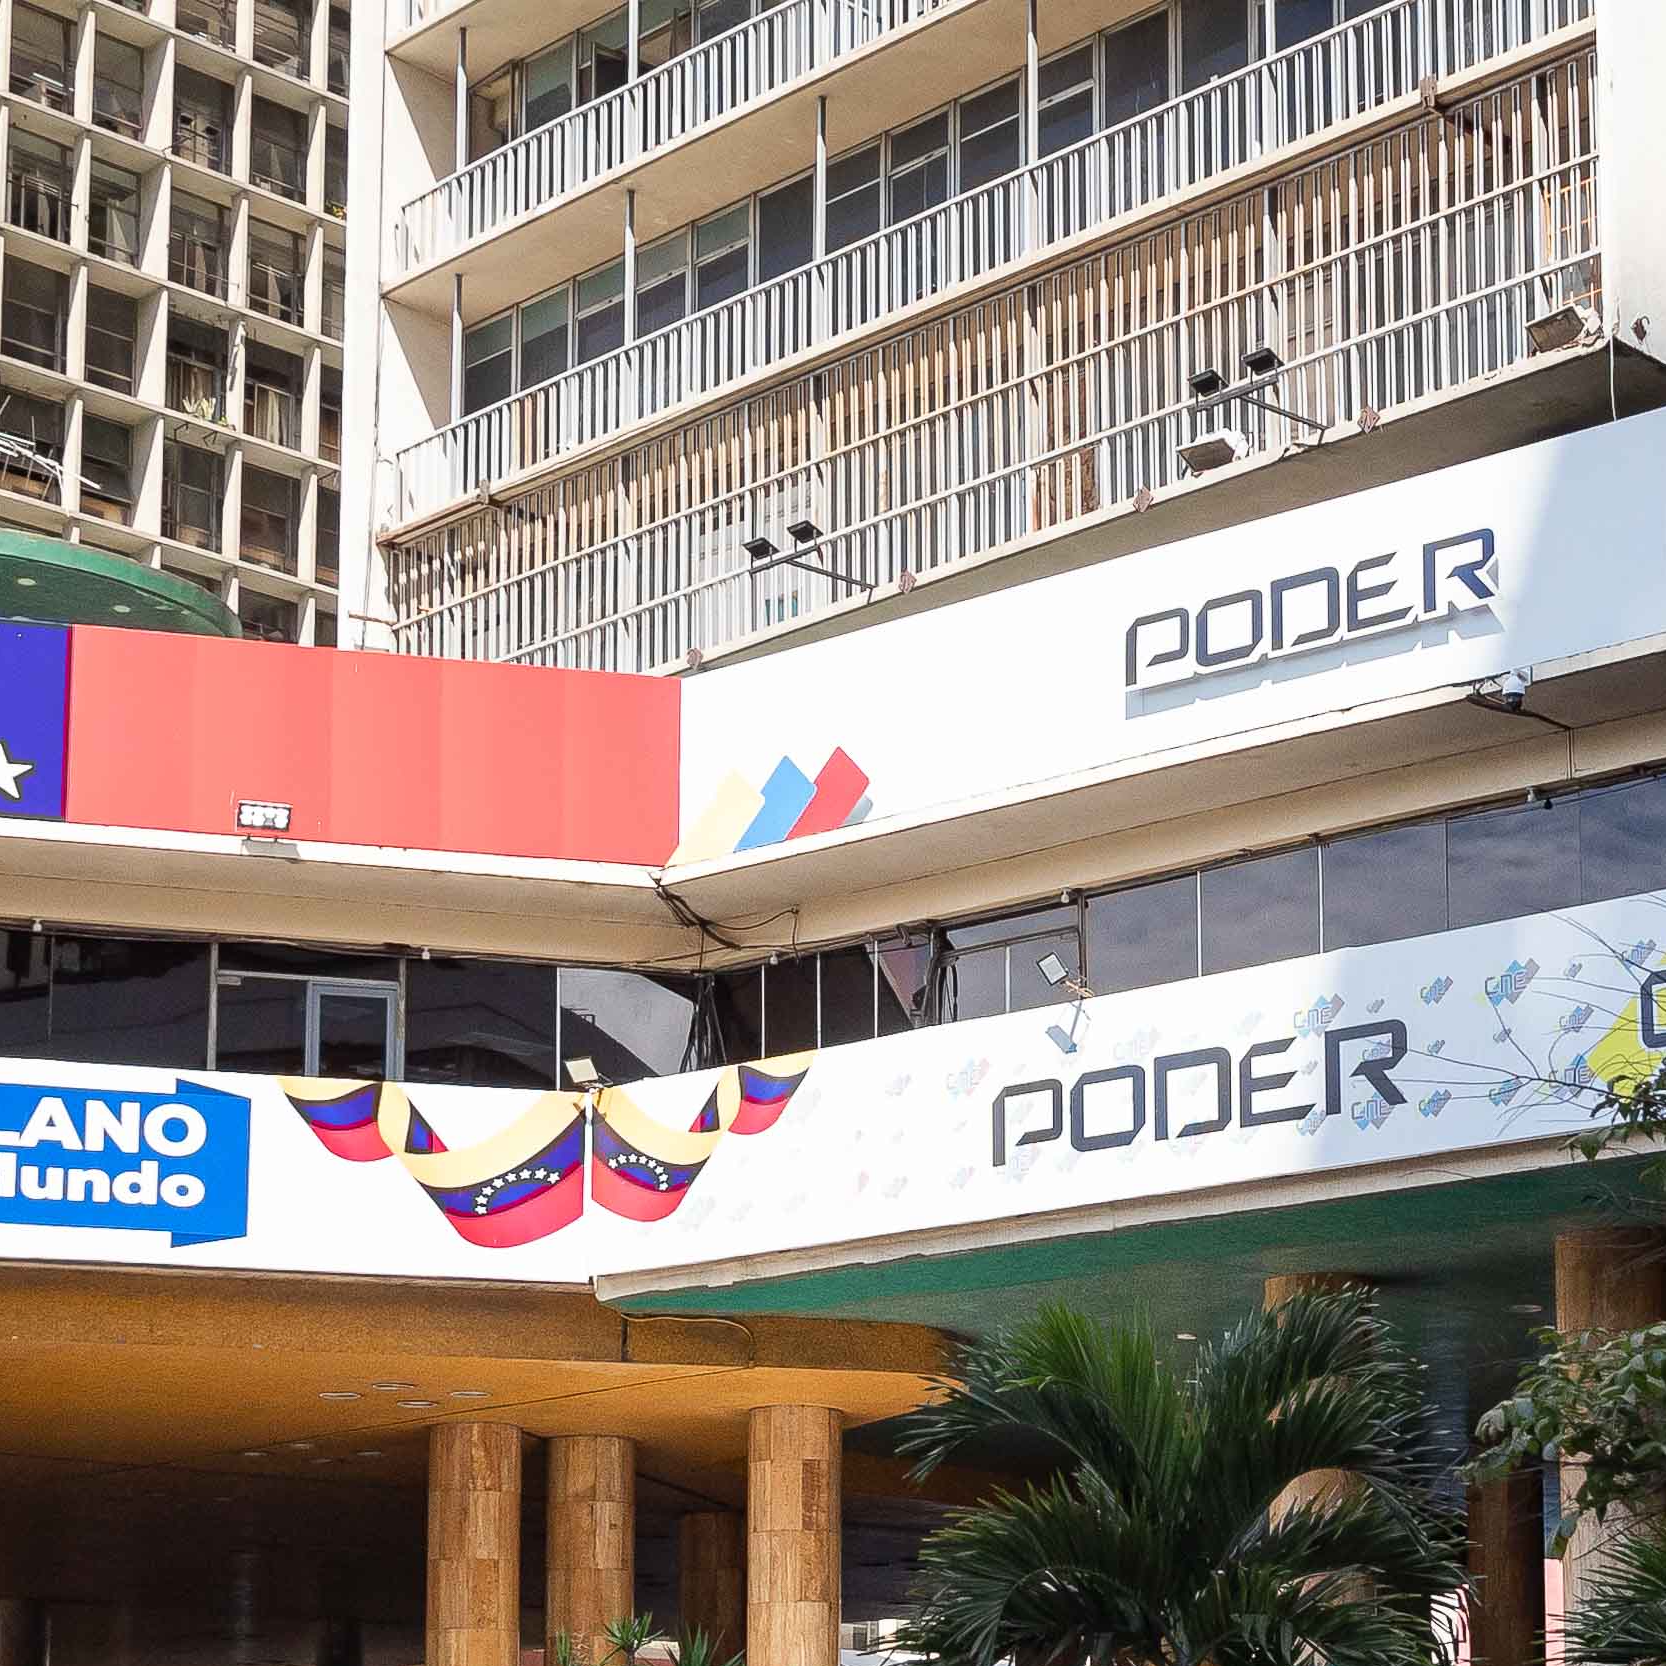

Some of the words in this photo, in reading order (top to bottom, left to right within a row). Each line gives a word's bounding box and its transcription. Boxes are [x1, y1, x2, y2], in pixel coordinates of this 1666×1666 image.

[1126, 528, 1495, 687] PODER
[1485, 971, 1527, 998] CNE
[992, 1018, 1408, 1167] PODER
